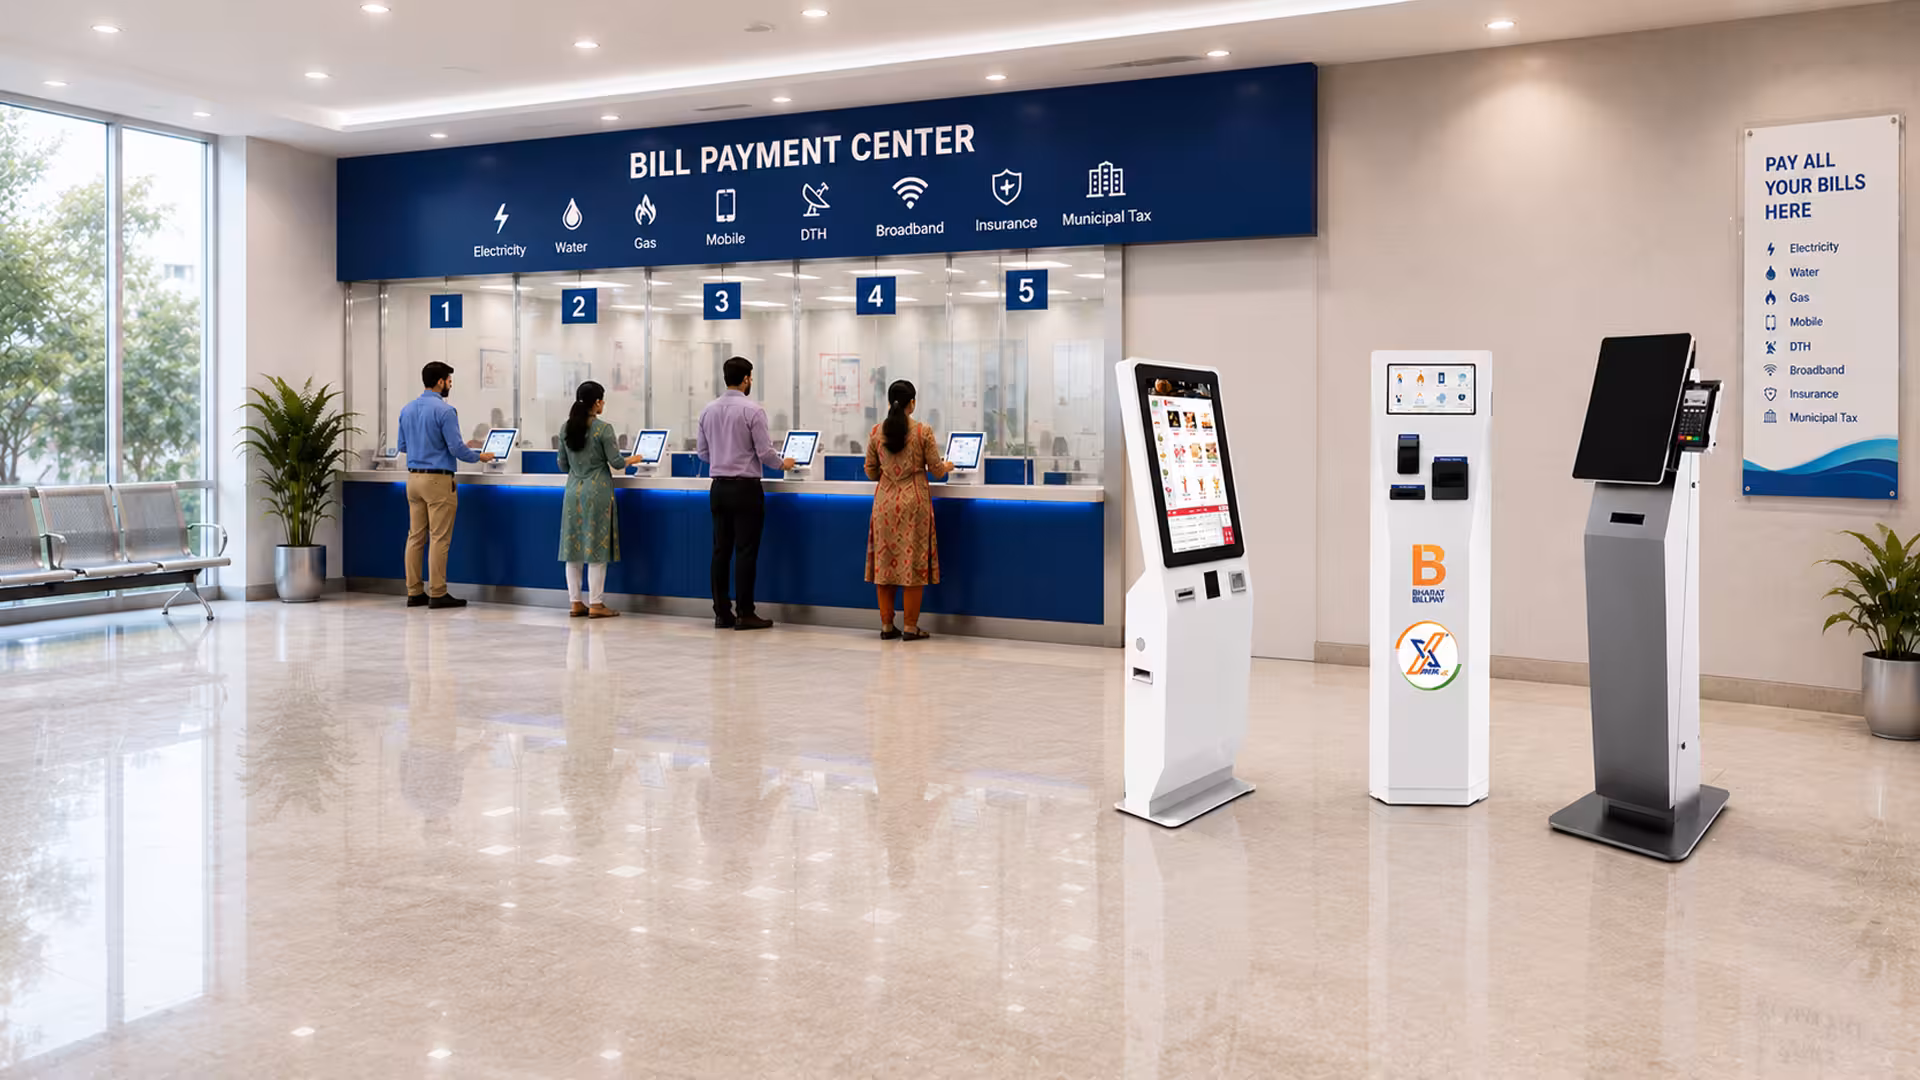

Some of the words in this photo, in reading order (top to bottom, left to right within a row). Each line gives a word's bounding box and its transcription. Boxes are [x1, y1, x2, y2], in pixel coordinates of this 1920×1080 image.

[630, 148, 691, 179] BILL
[701, 134, 842, 174] PAYMENT
[851, 123, 975, 162] CENTER
[1765, 154, 1799, 172] PAY
[1803, 151, 1836, 170] ALL
[1764, 177, 1813, 197] YOUR
[1817, 173, 1866, 193] BILLS
[1062, 209, 1125, 227] Municipal
[1127, 209, 1152, 222] Tax
[1765, 201, 1812, 221] HERE
[876, 220, 944, 237] Broadband
[975, 218, 1038, 232] Insurance
[706, 232, 746, 246] Mobile
[800, 227, 827, 241] DTH
[473, 243, 527, 258] Electricity
[554, 241, 588, 254] Water
[634, 237, 657, 250] Gas
[1789, 241, 1840, 254] Electricity
[1789, 267, 1820, 278] Water
[867, 284, 884, 308] 4
[1018, 278, 1035, 303] 5
[1789, 292, 1810, 303] Gas
[572, 295, 586, 318] 2
[714, 290, 729, 313] 3
[441, 301, 450, 322] 1
[1790, 316, 1824, 327] Mobile
[1789, 341, 1811, 352] DTH
[1789, 364, 1845, 376] Broadband
[1789, 389, 1839, 399] Insurance
[1789, 412, 1838, 425] Municipal
[1839, 412, 1858, 423] Tax
